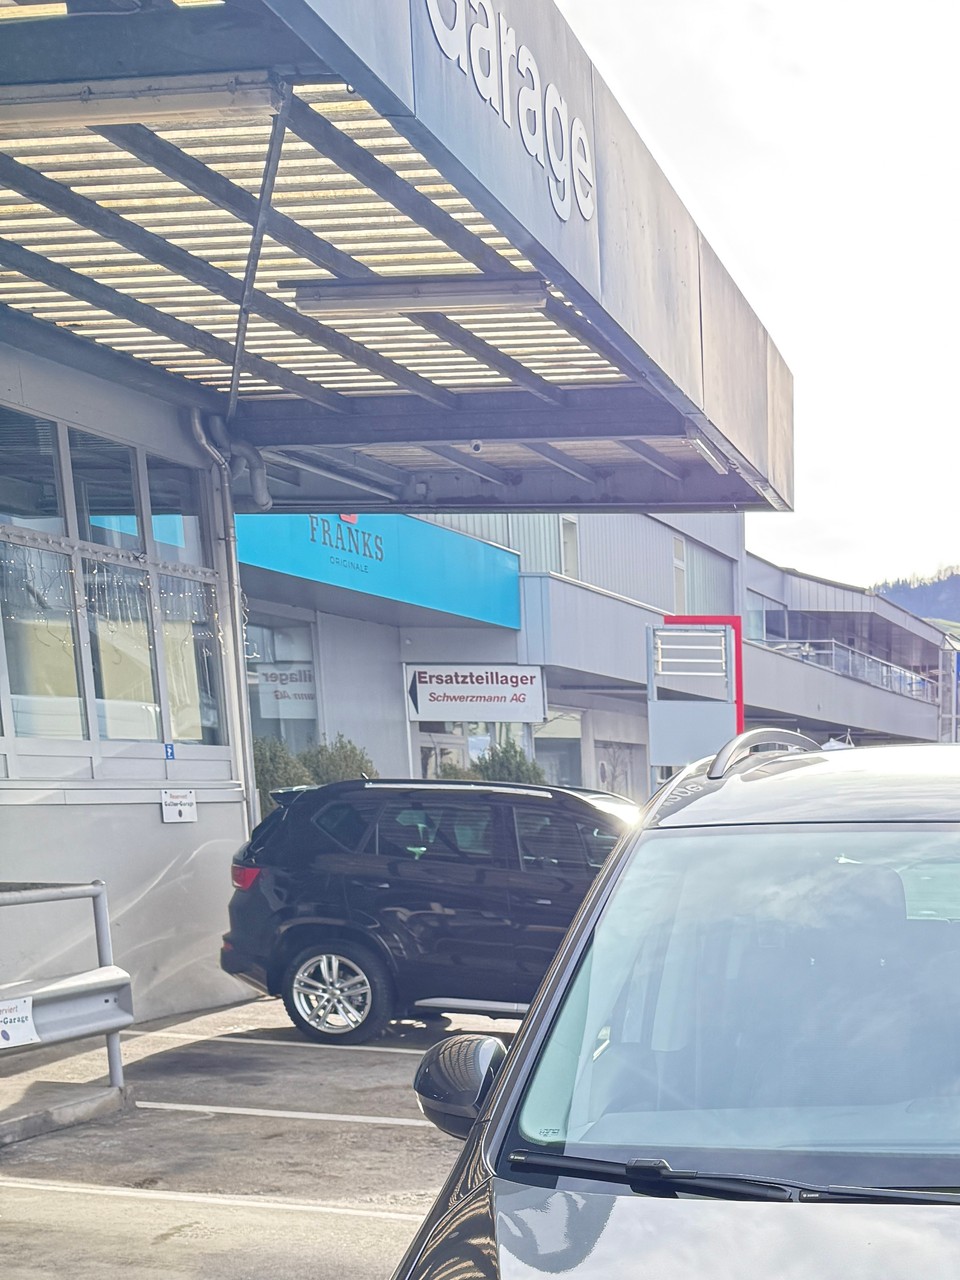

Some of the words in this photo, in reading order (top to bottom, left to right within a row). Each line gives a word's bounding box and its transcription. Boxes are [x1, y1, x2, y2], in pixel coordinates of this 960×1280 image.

[308, 514, 384, 562] FRANKS
[329, 556, 369, 574] ORIGINALE
[417, 670, 536, 689] Ersatzteillager
[428, 691, 507, 704] Schwerzmann
[509, 693, 526, 704] AG
